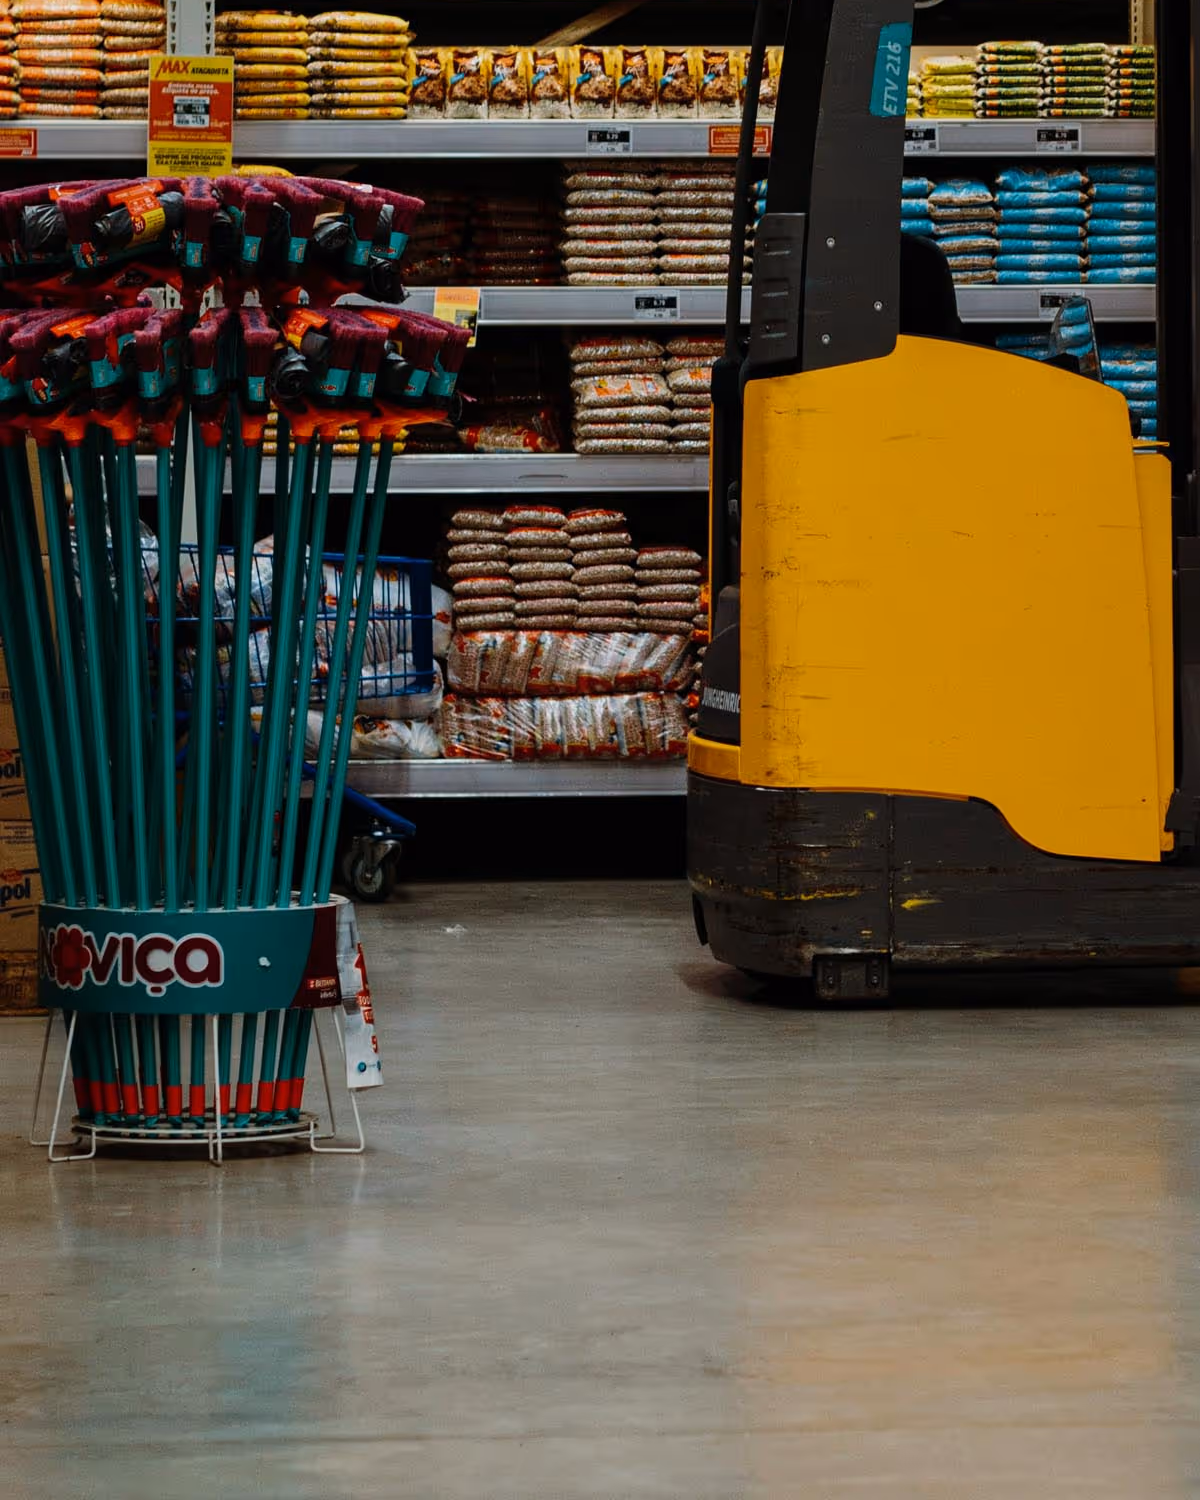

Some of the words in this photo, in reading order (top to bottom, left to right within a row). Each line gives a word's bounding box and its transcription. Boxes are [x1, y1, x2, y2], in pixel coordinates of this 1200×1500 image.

[155, 60, 191, 78] MAX
[191, 67, 229, 75] ATACADISTA
[888, 40, 902, 73] 216
[883, 85, 898, 116] ETV
[701, 687, 740, 714] JUNGHEINRIC
[0, 877, 31, 902] pol
